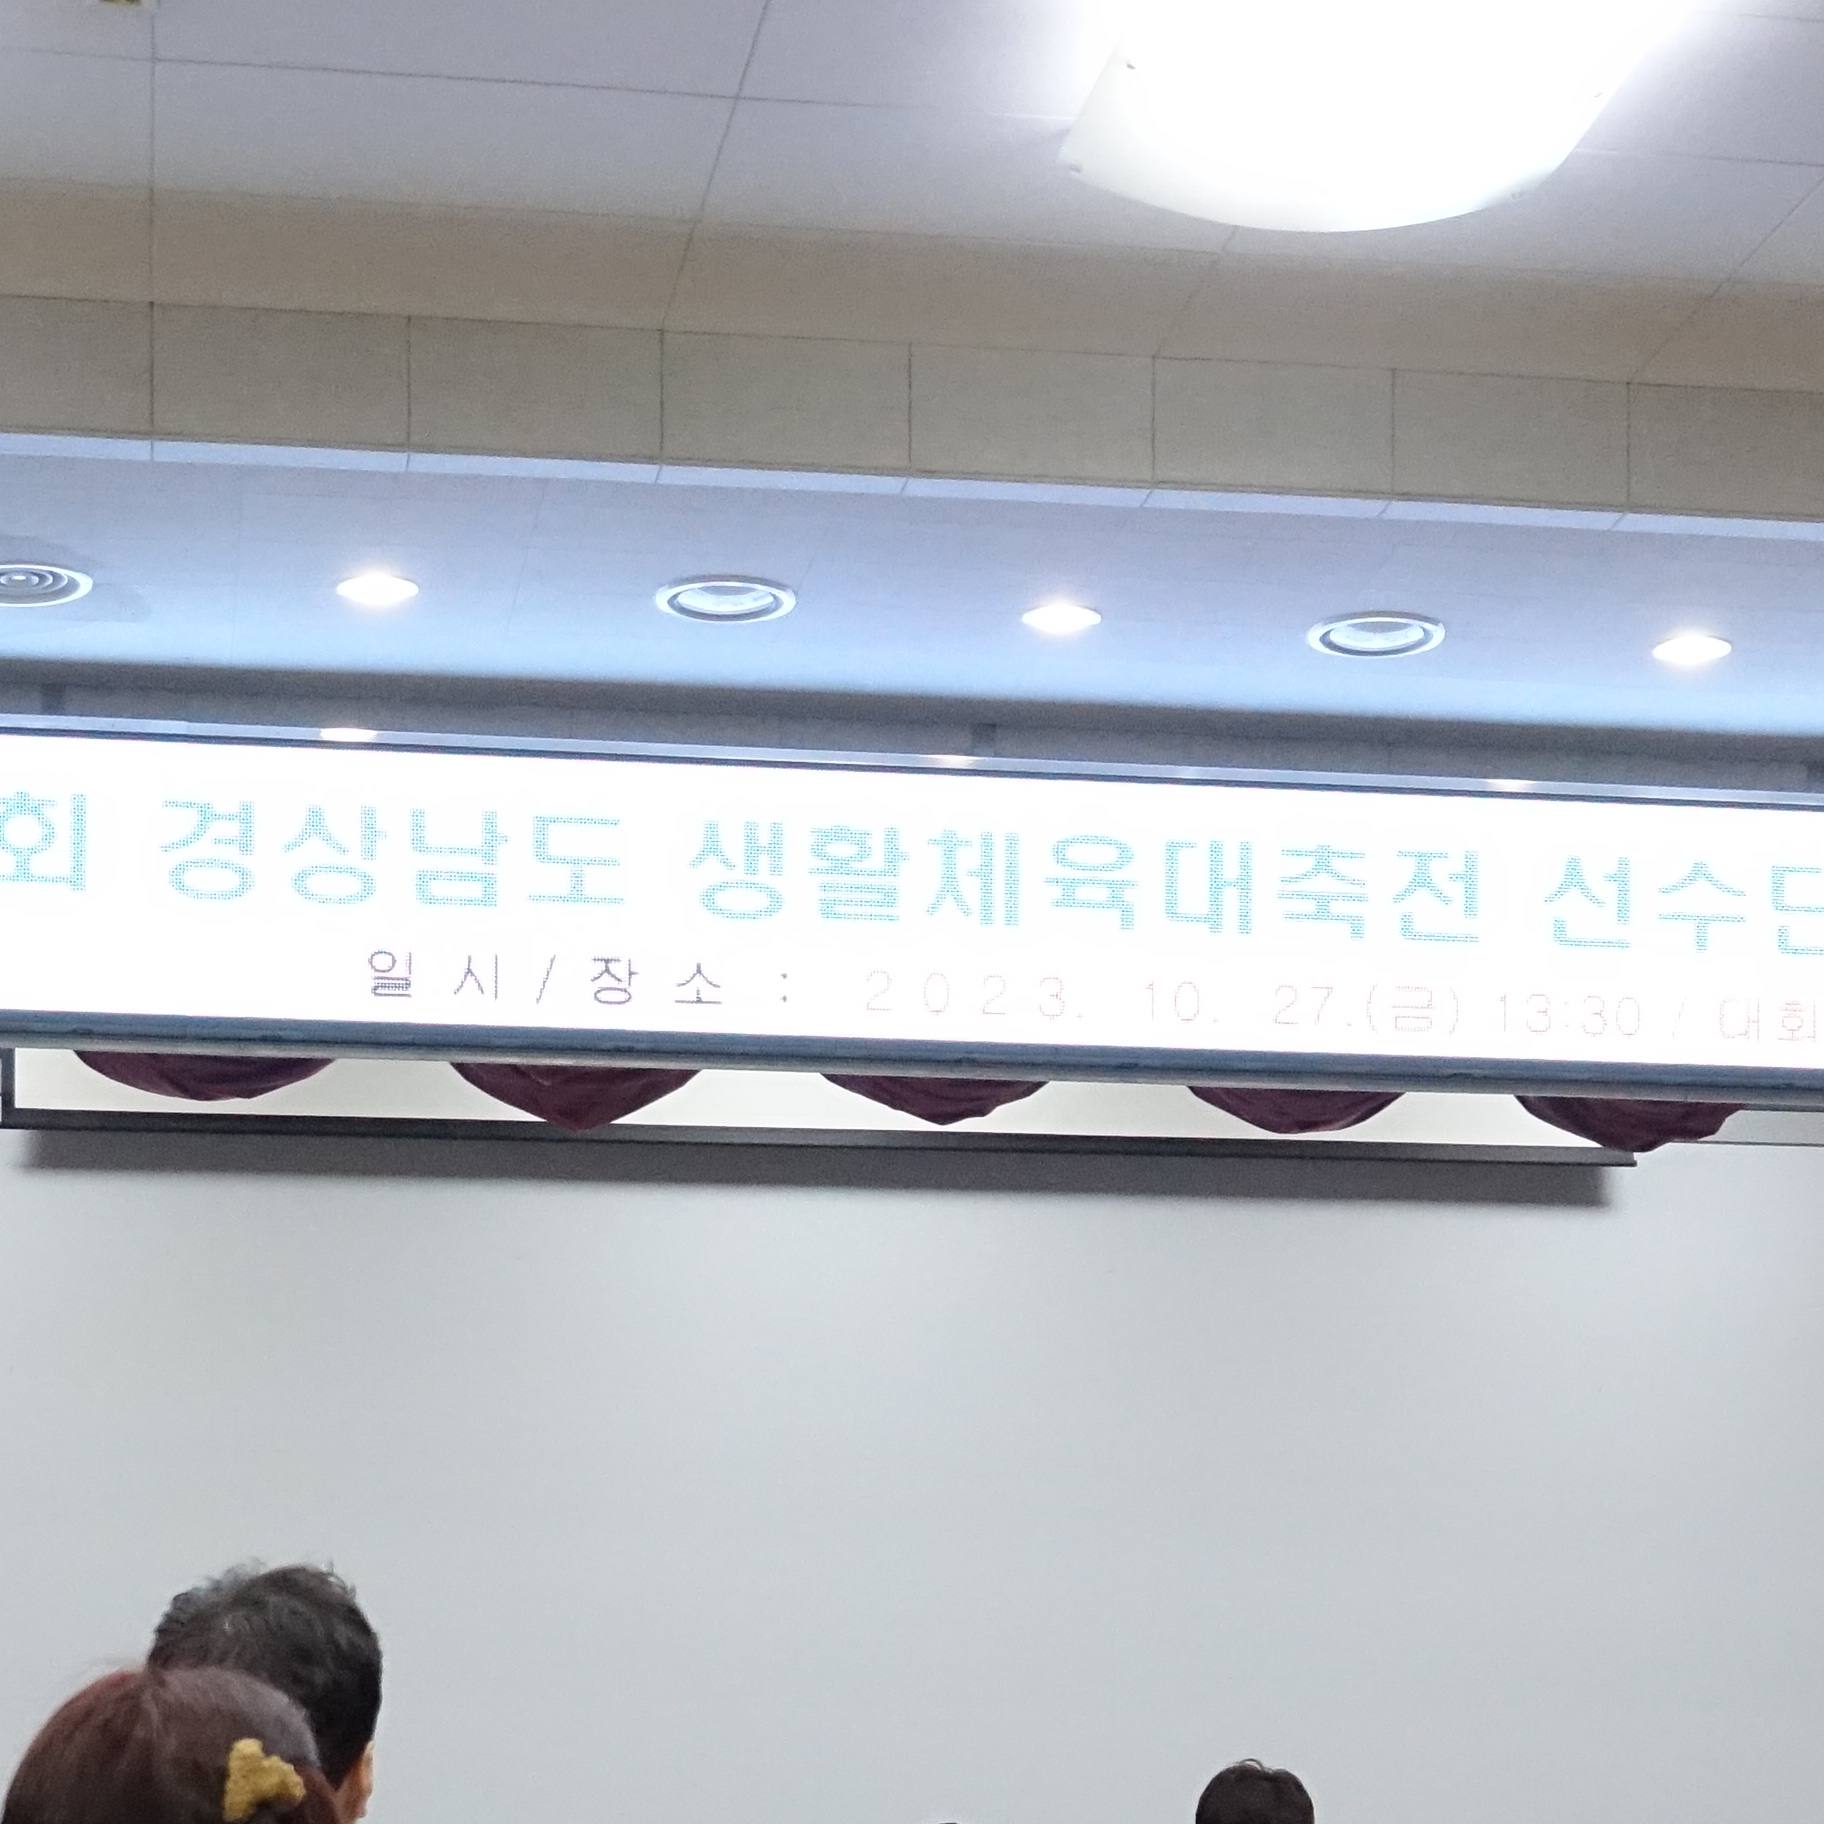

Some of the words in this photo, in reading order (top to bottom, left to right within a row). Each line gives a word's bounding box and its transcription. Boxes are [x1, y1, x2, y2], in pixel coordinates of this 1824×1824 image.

[160, 797, 625, 909] 경상남도
[689, 819, 1480, 943] 생활체육대축전
[865, 969, 1085, 1020] 2023.
[1144, 979, 1219, 1025] 10.
[1497, 992, 1643, 1039] 13:30
